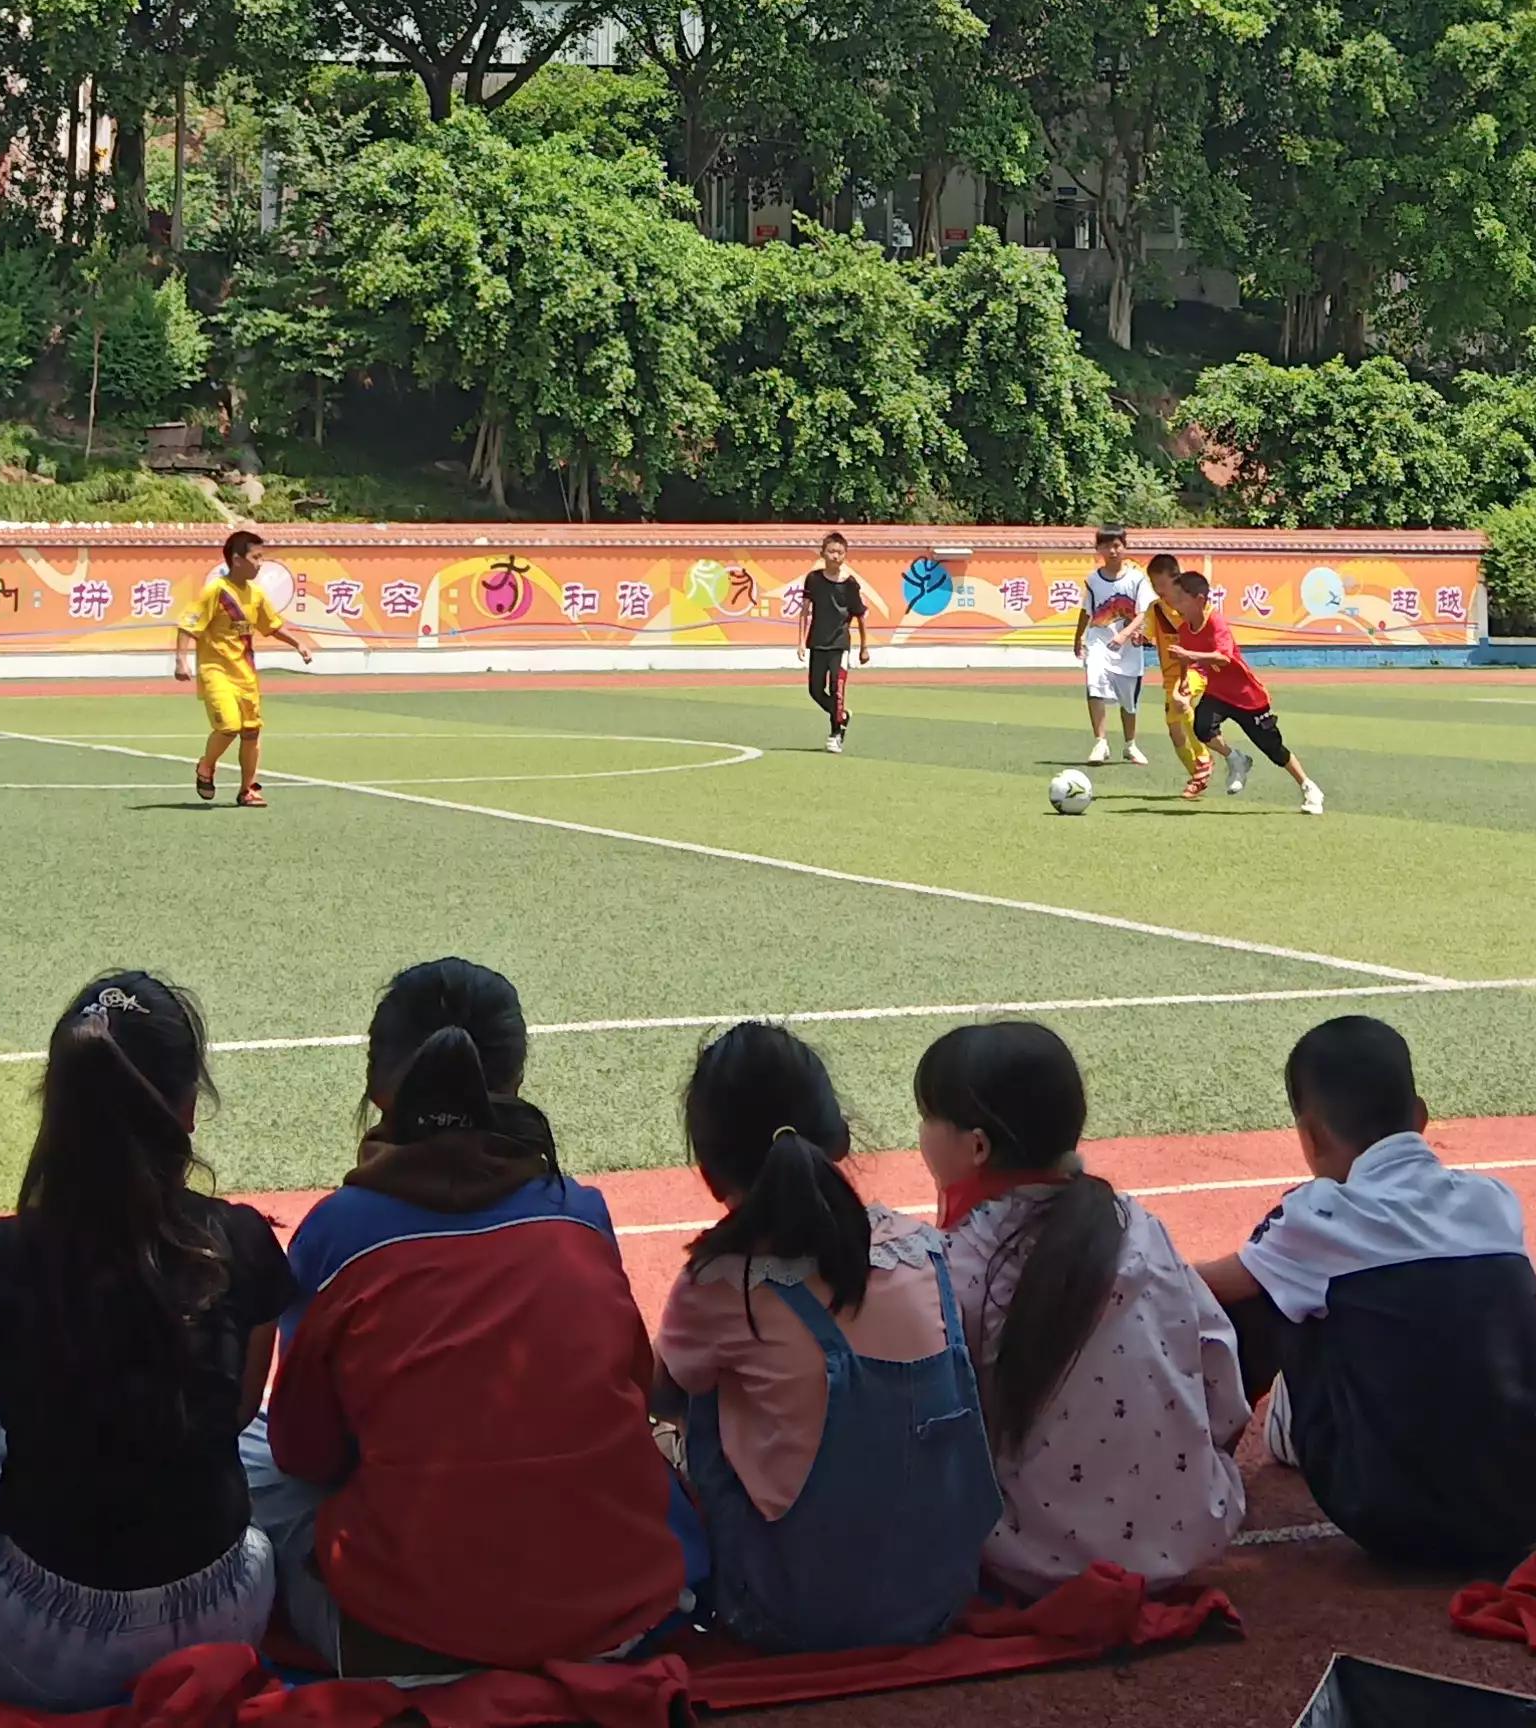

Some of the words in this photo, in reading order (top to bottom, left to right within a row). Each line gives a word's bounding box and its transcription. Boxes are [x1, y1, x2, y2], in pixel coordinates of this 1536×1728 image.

[71, 582, 171, 618] 拼搏
[324, 580, 420, 616] 宽容
[563, 584, 651, 617] 和谐
[998, 580, 1080, 612] 博学
[1391, 589, 1465, 619] 超越
